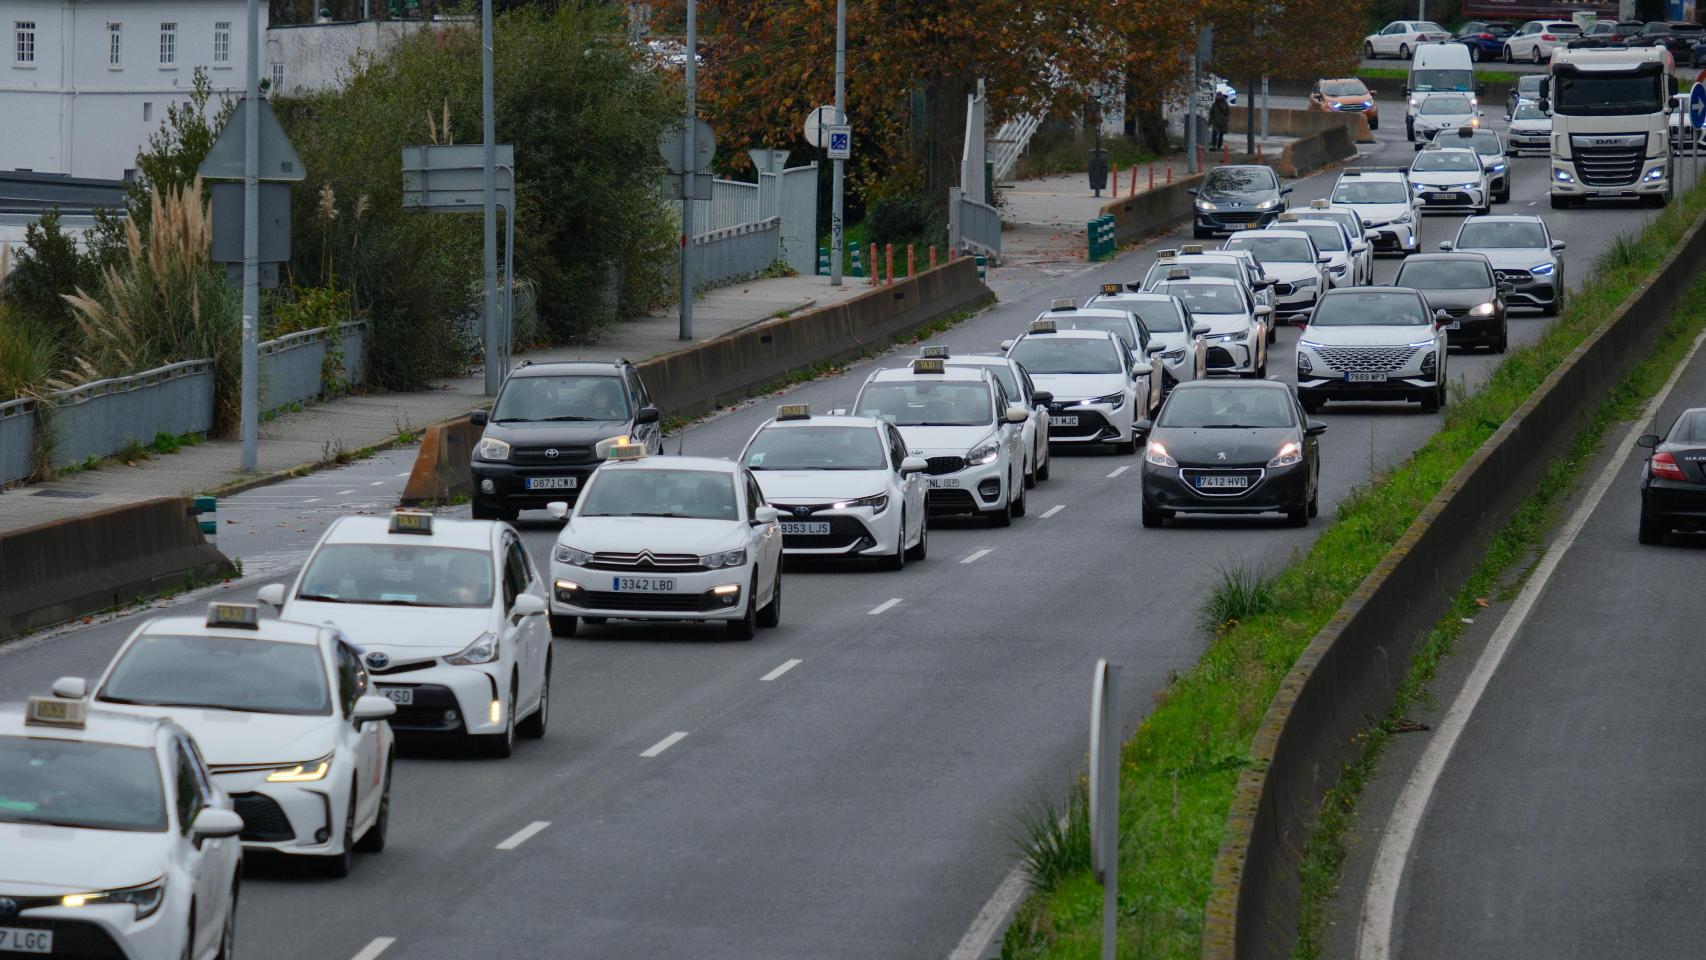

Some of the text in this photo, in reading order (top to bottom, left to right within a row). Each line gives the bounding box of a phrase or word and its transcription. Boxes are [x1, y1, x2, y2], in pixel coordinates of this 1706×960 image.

[921, 361, 934, 369] TAXI
[785, 407, 799, 415] TAXI
[1061, 417, 1077, 425] MJC
[533, 479, 575, 488] 0871 CWX
[1201, 476, 1247, 486] 7412 HVD
[398, 516, 419, 528] TAXI
[781, 523, 828, 533] 9353 LJS
[621, 580, 674, 591] 3342 LBD
[219, 606, 242, 620] TAXI
[13, 931, 47, 950] LGC
